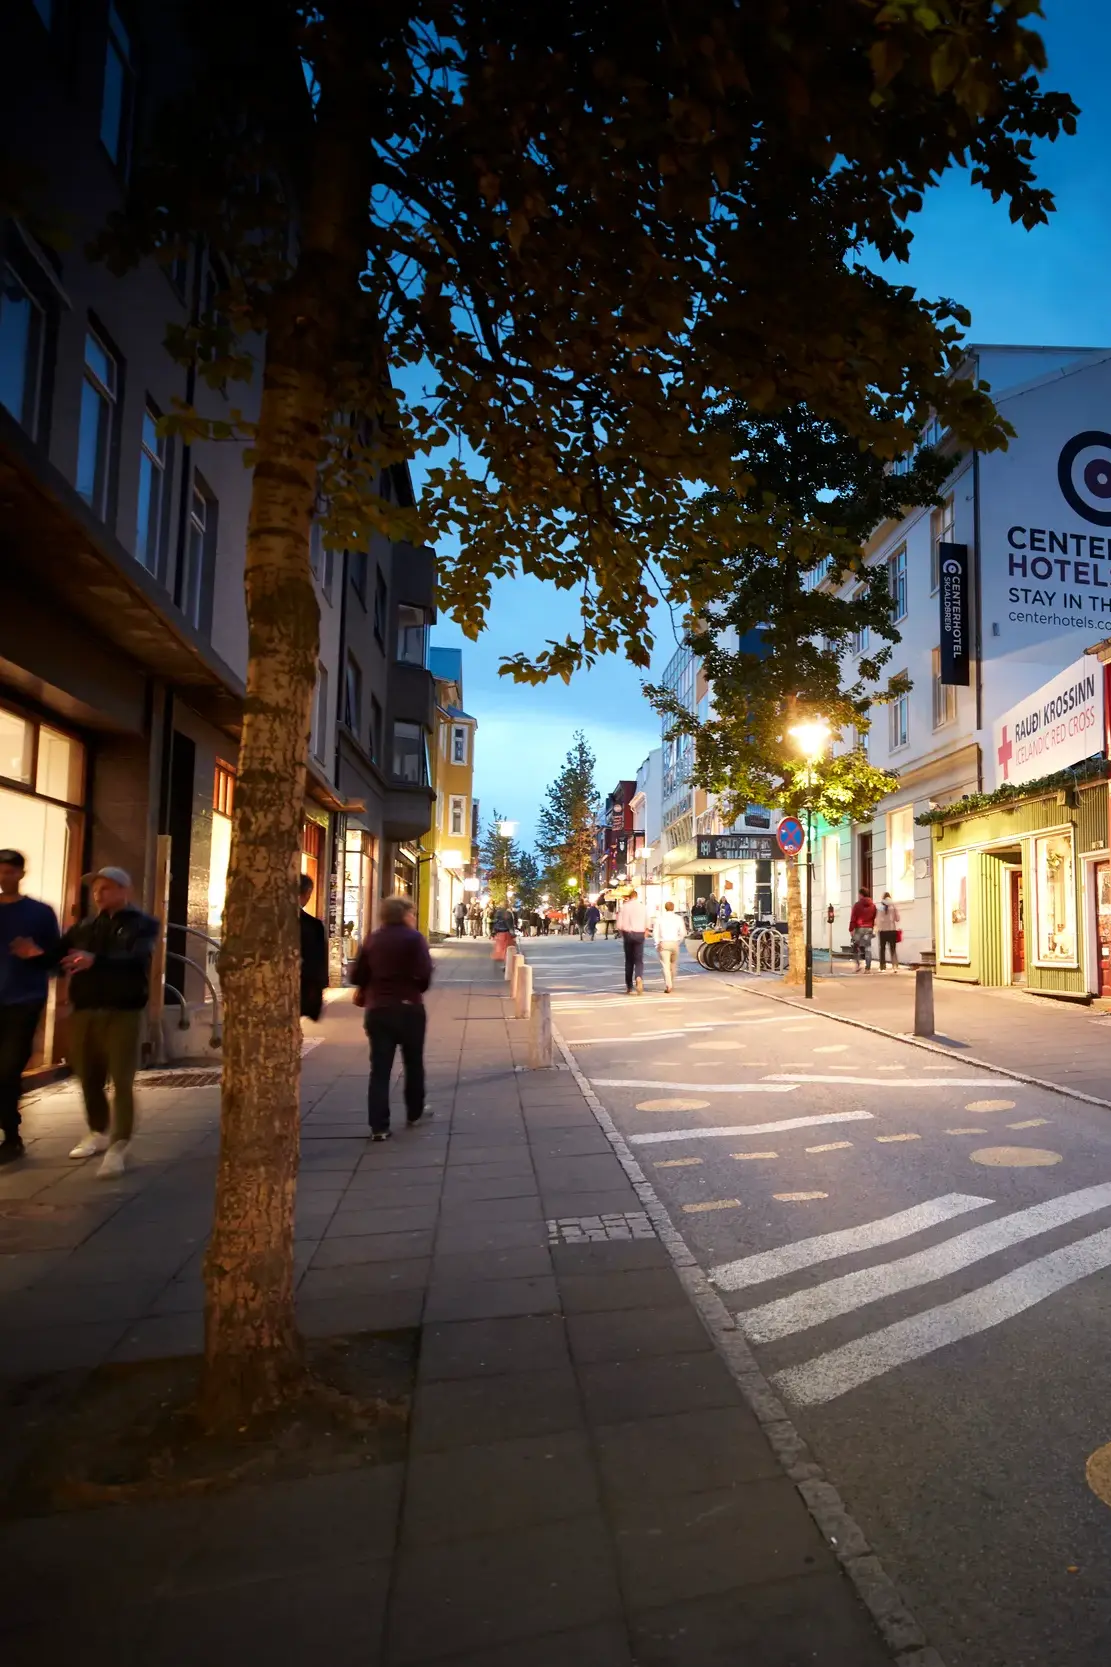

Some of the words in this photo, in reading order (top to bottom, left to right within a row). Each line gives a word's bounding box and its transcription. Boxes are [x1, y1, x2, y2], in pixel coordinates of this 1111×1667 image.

[951, 576, 962, 658] CENTERHOTEL
[1008, 587, 1056, 606] STAY
[1064, 593, 1082, 609] IN
[1015, 709, 1041, 743] RAUÐI
[1043, 674, 1095, 726] KROSSINN
[1016, 731, 1050, 766] ICELANDIC
[1051, 723, 1066, 746] RED
[1068, 705, 1095, 737] CROSS
